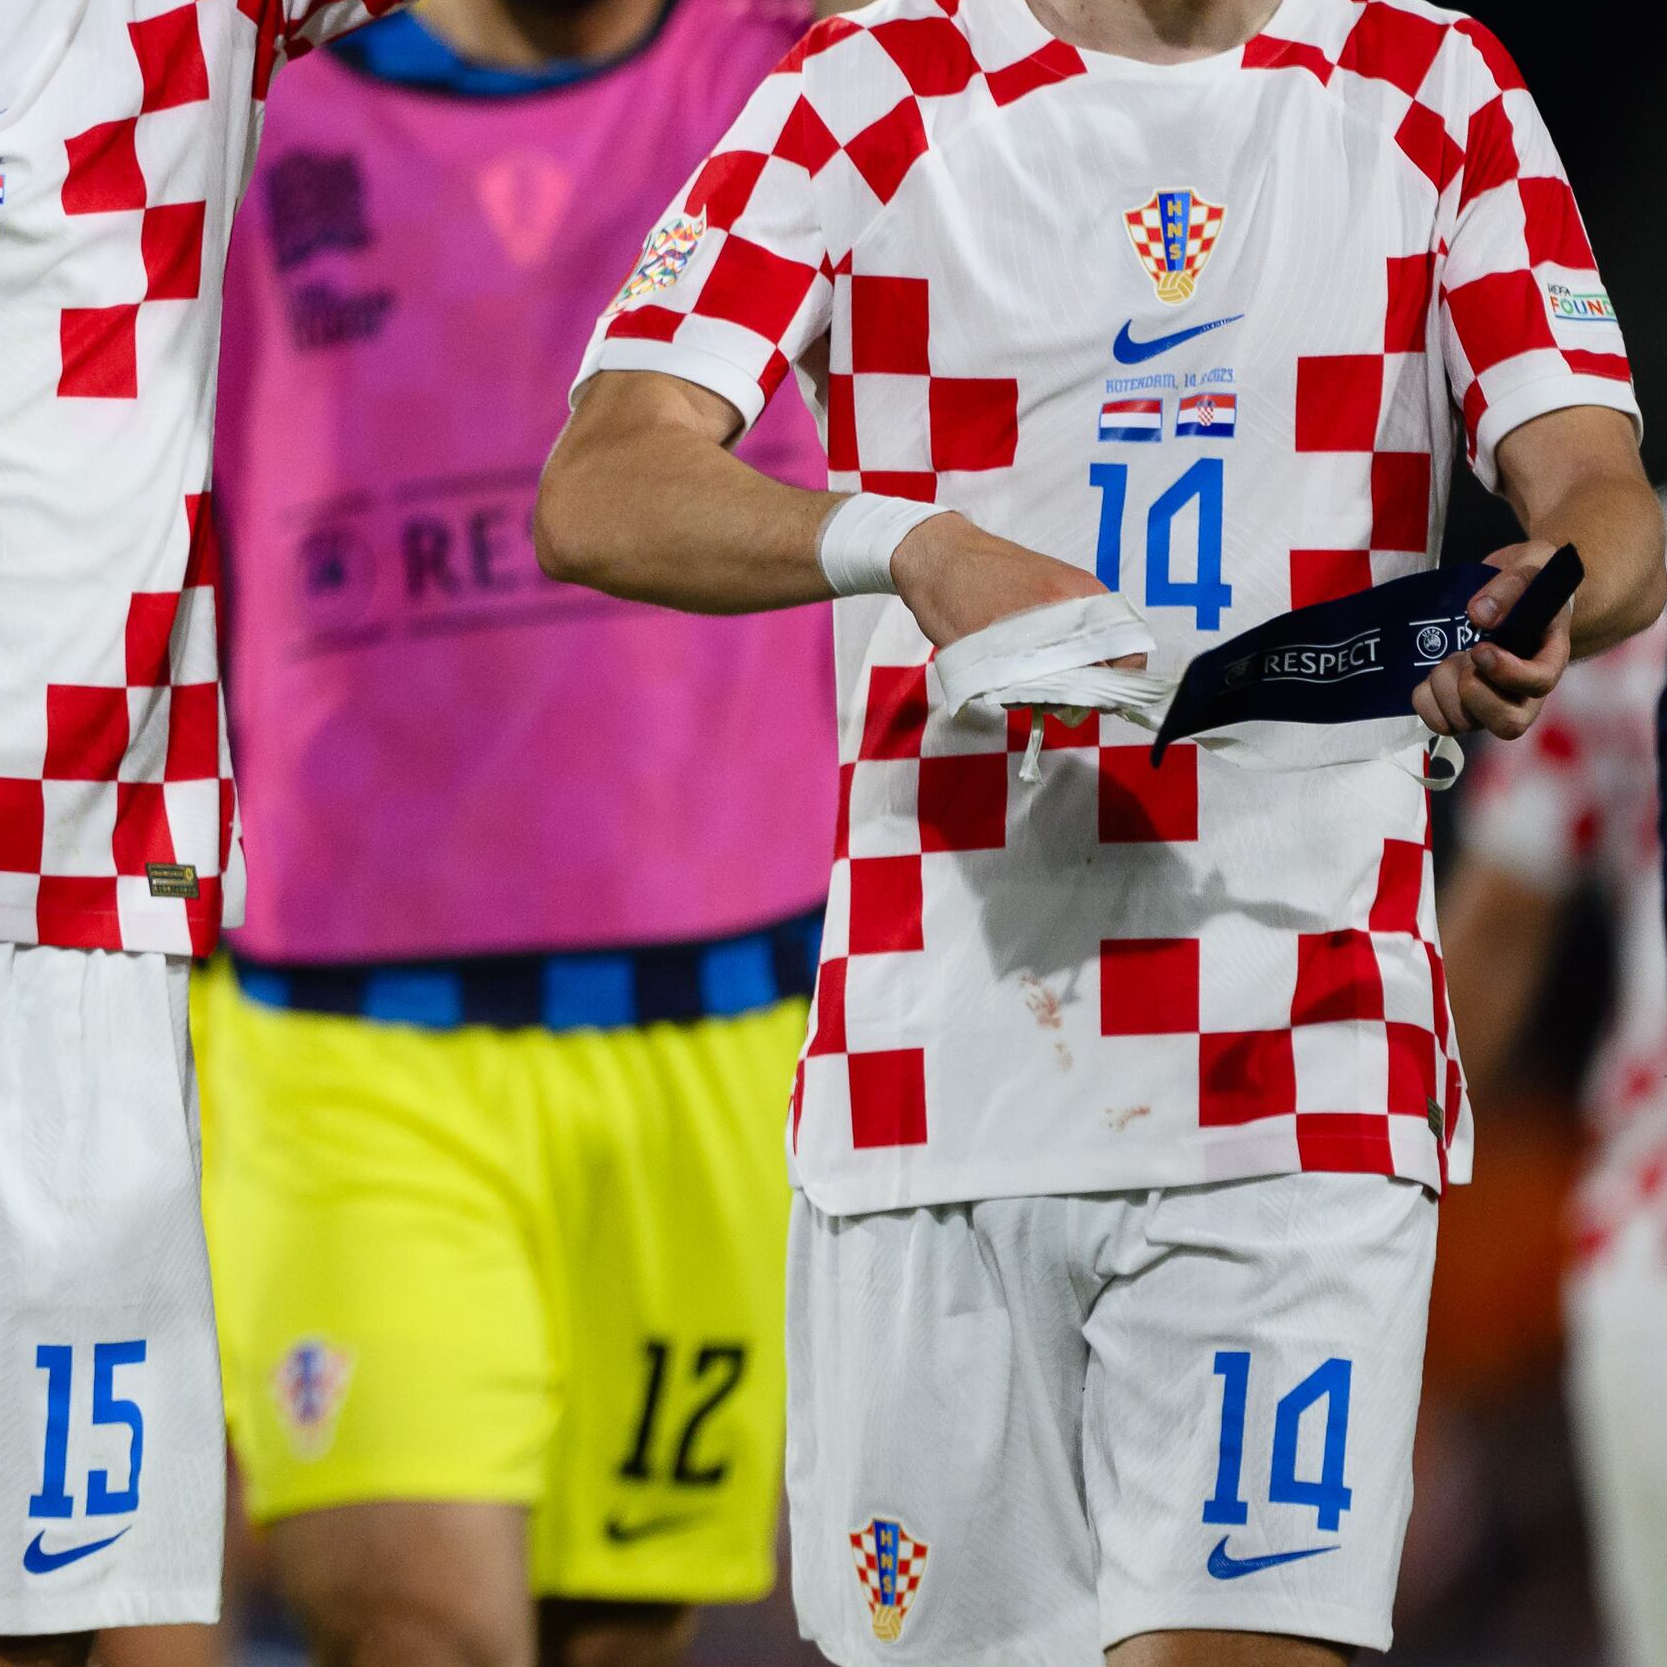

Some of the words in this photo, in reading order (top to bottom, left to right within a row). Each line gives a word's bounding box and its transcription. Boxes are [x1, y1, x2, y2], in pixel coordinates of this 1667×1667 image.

[1167, 200, 1182, 261] HNS
[1090, 457, 1232, 631] 14
[1264, 637, 1381, 675] RESPECT
[29, 1339, 147, 1519] 15
[619, 1340, 745, 1487] 12
[1202, 1351, 1352, 1532] 14
